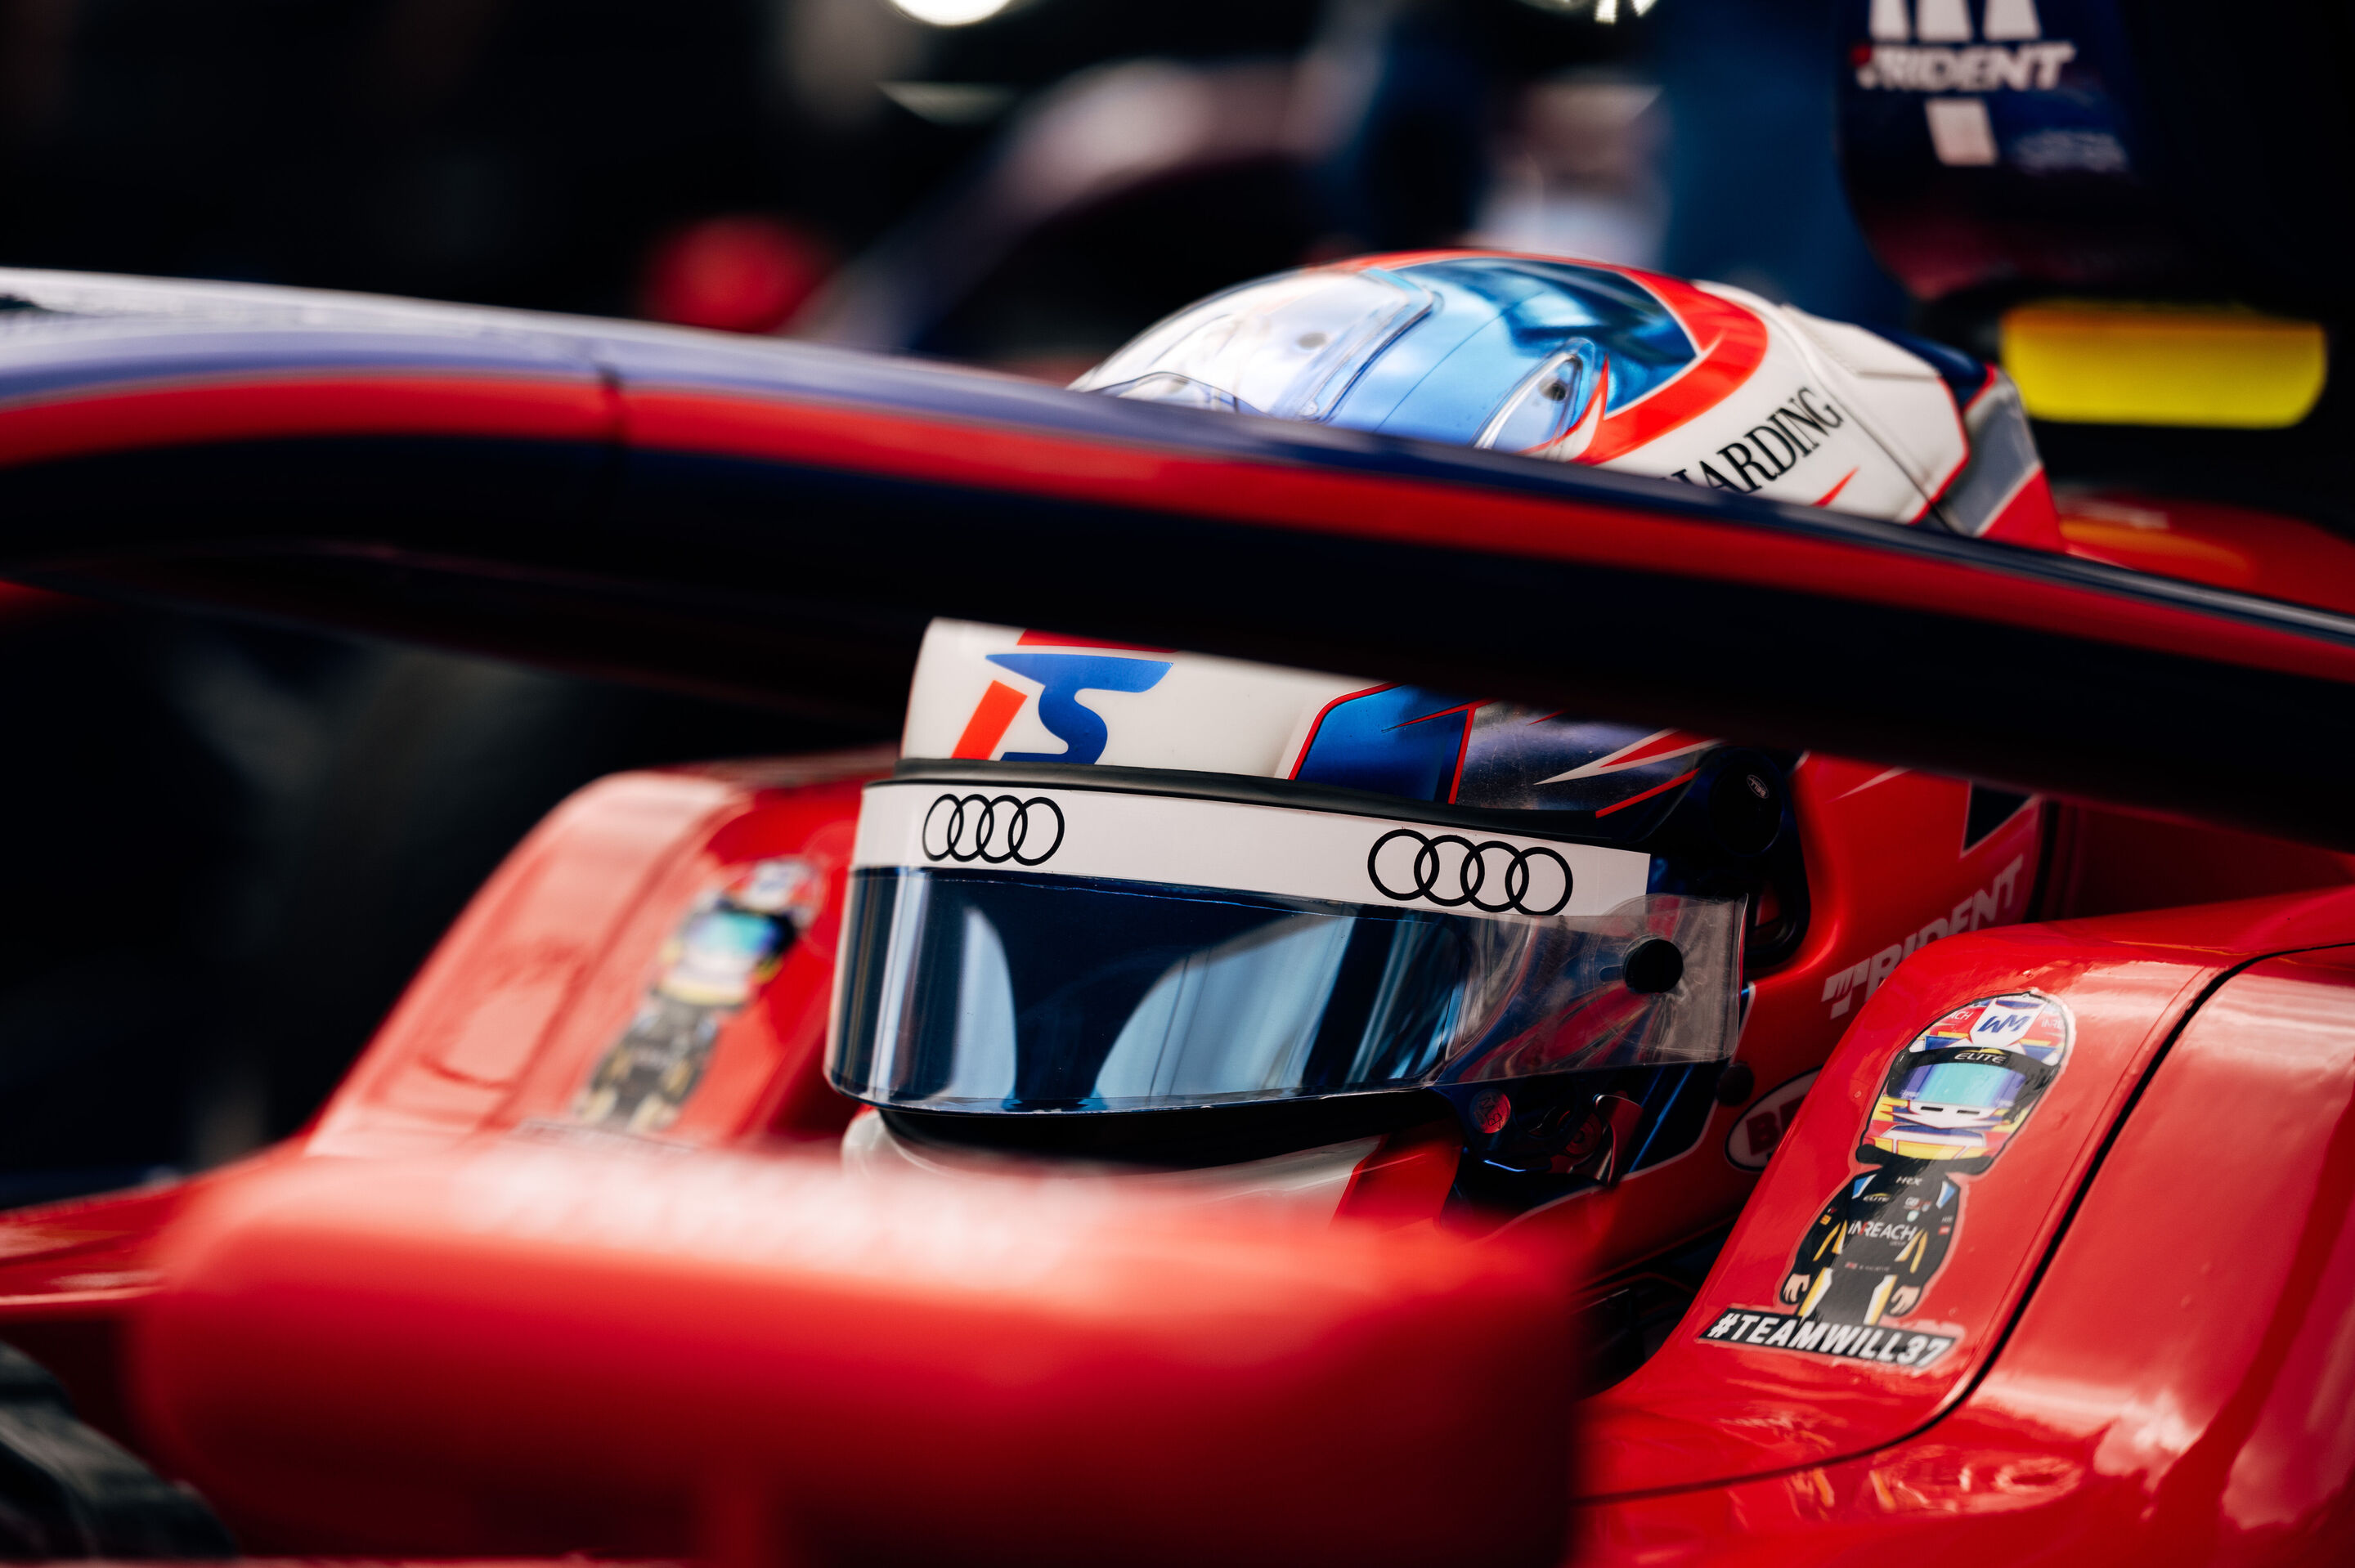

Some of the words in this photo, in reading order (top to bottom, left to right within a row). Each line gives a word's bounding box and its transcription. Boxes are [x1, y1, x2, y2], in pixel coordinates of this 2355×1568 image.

[1660, 386, 1844, 495] ARDING
[1954, 1051, 2007, 1064] ELITE
[1848, 1221, 1918, 1241] INREACH
[1707, 1312, 1953, 1368] #TEAMWILL37
